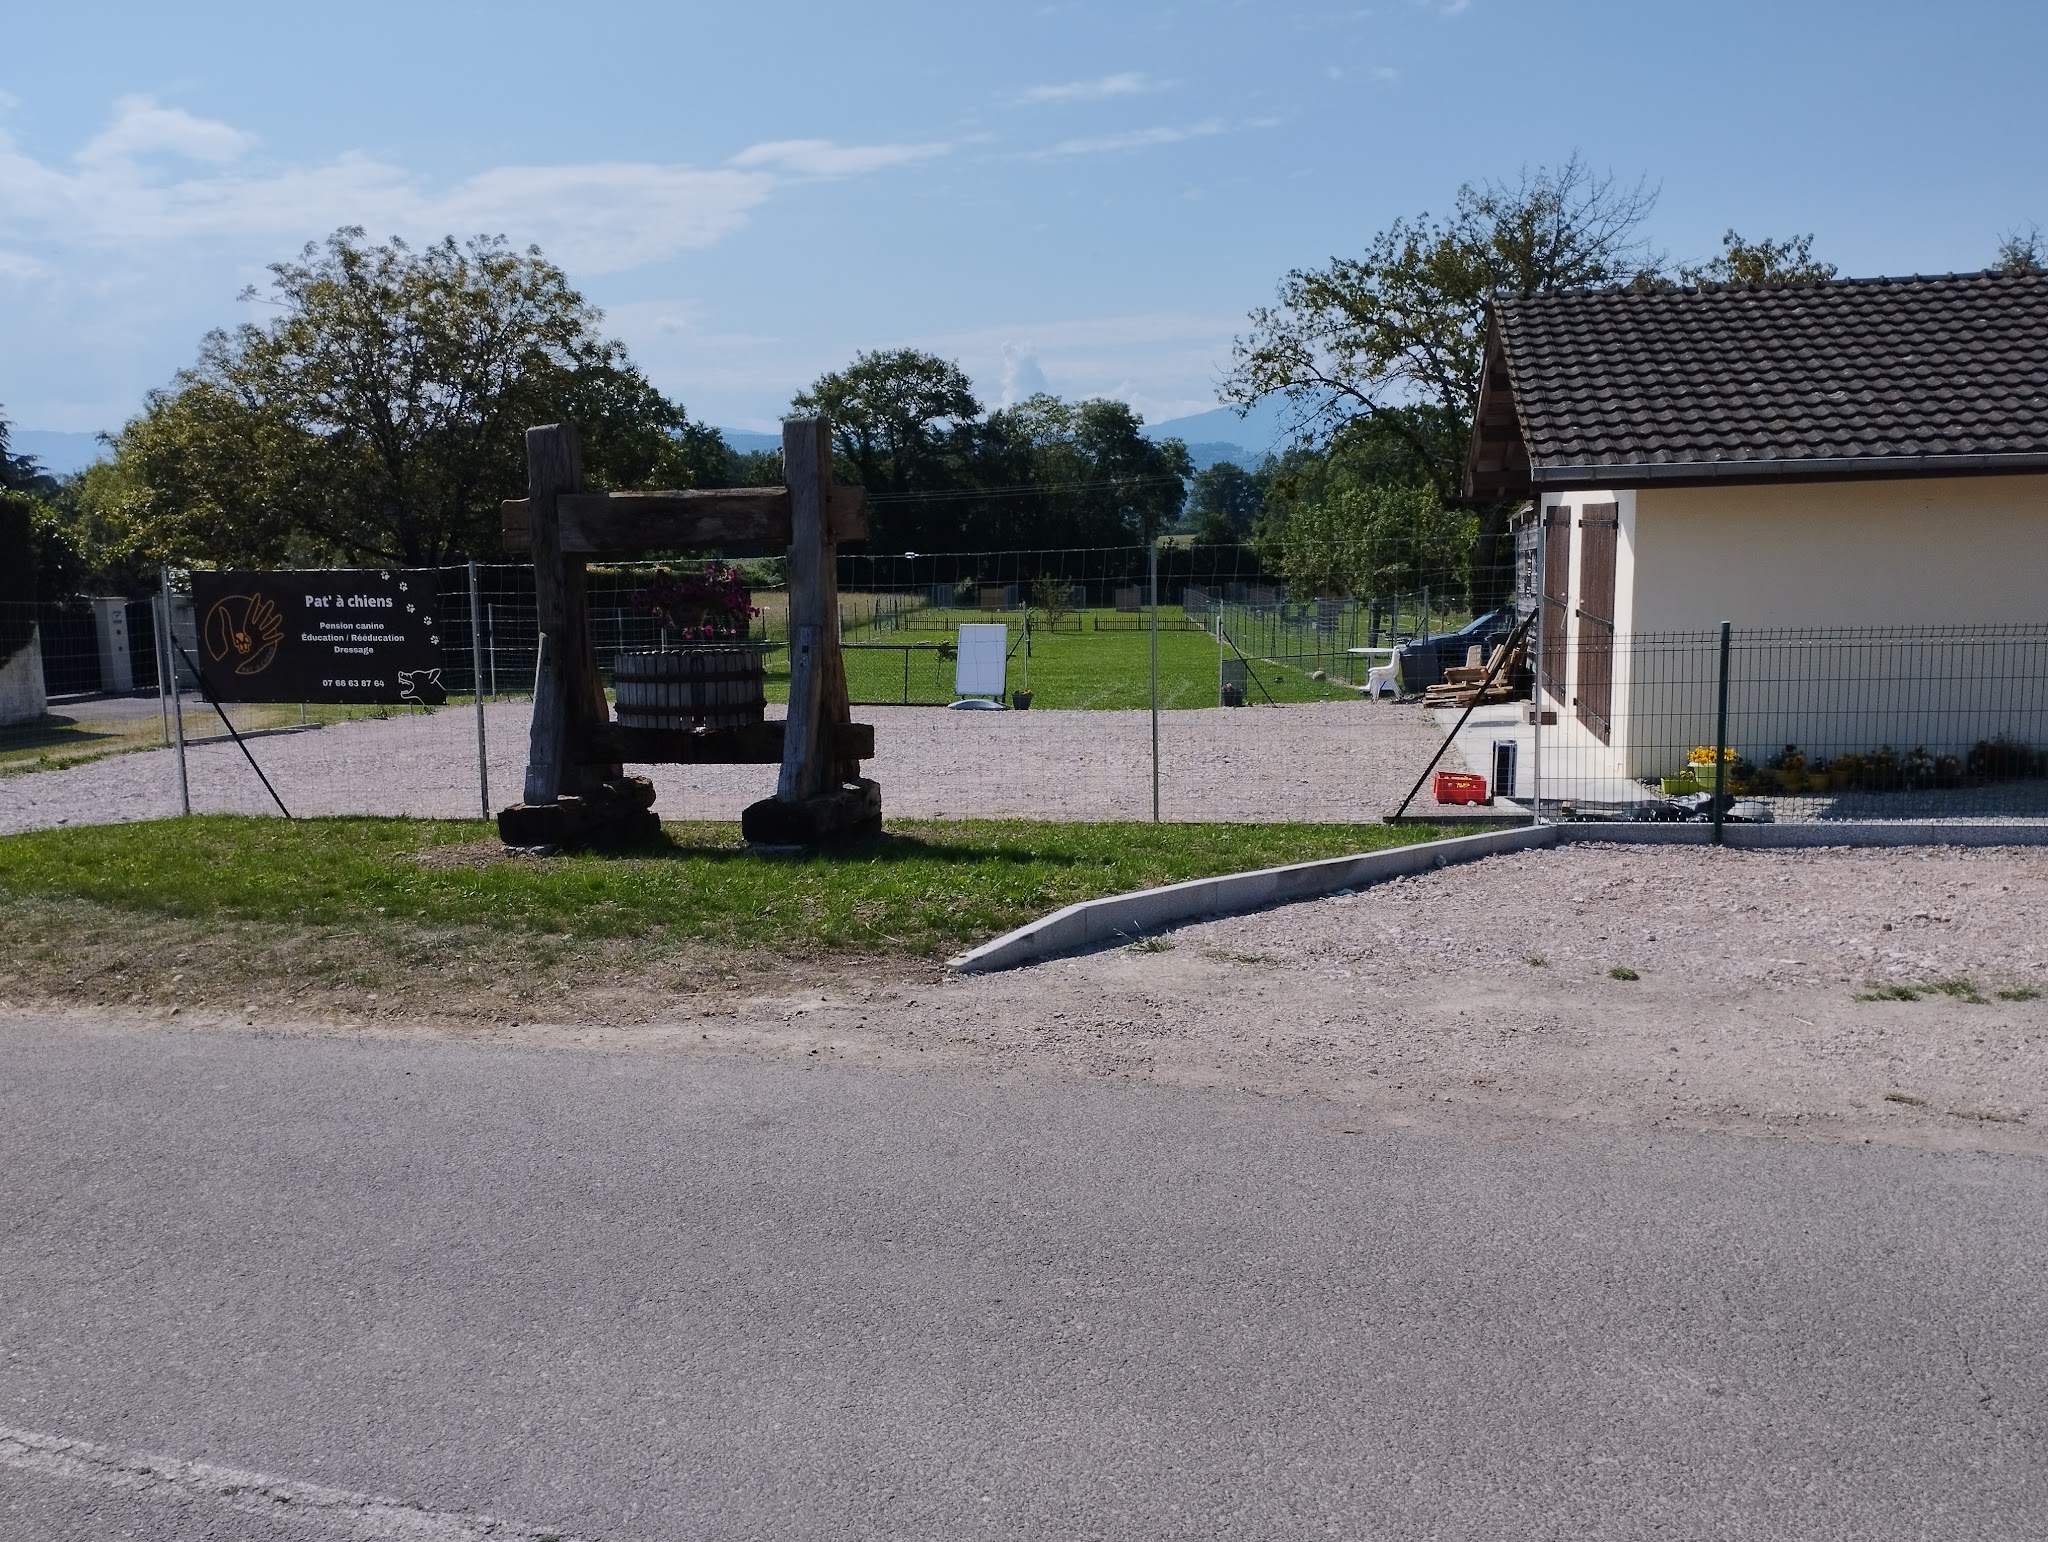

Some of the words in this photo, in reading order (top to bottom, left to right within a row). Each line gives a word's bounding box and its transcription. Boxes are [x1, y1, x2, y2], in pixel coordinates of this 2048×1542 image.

[305, 595, 332, 607] Pat'
[336, 595, 345, 607] à
[347, 594, 393, 607] chiens
[319, 622, 354, 630] Pension
[355, 622, 385, 630] canine
[301, 632, 345, 642] Éducation
[350, 633, 405, 642] Rééducation
[333, 646, 374, 655] Dressage
[322, 679, 333, 687] 07
[347, 679, 360, 687] 63
[360, 679, 372, 687] 87
[373, 679, 385, 687] 64
